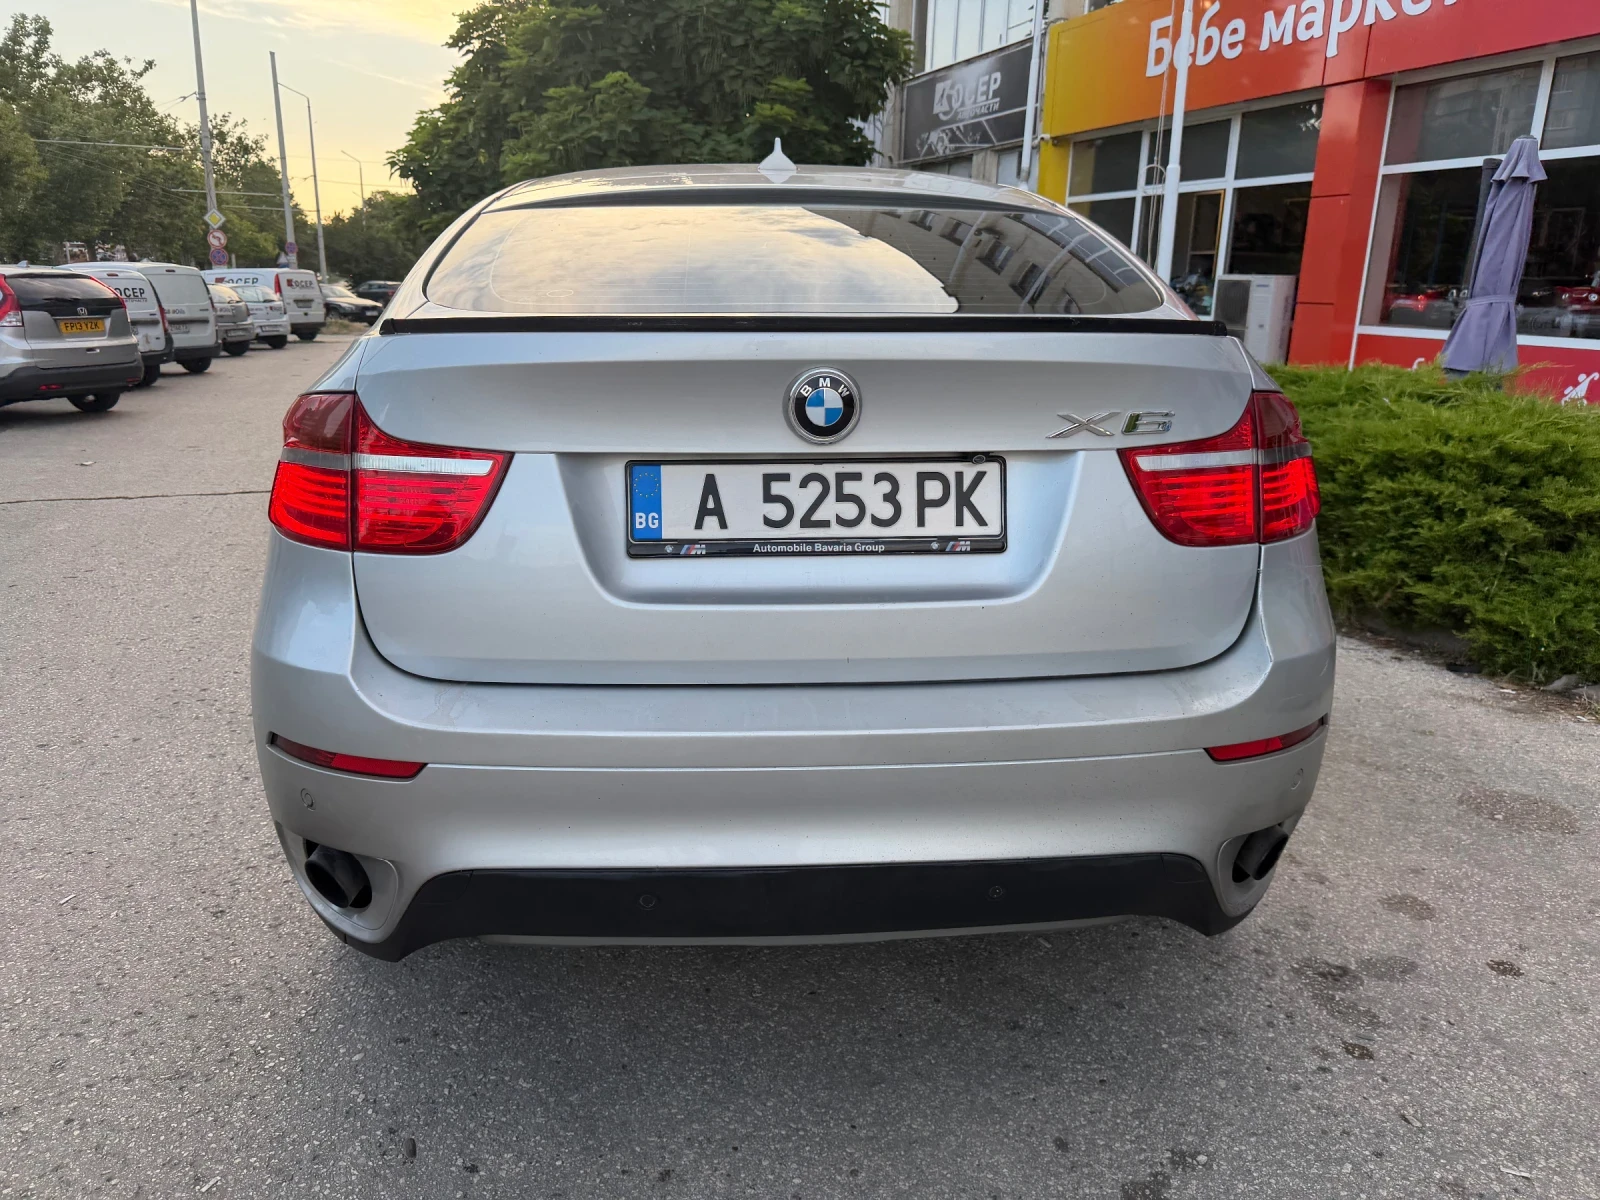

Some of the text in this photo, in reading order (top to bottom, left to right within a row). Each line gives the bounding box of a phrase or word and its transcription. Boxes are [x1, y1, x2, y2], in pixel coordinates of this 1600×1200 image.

[1146, 0, 1246, 77] Бебе
[114, 287, 145, 298] ОСЕР
[64, 321, 100, 331] FP13 YZK
[800, 377, 850, 398] BMW
[1045, 410, 1175, 438] X6
[694, 471, 988, 530] A 5253 PK
[635, 512, 659, 529] BG
[753, 542, 885, 554] Automobile Bavaria Group
